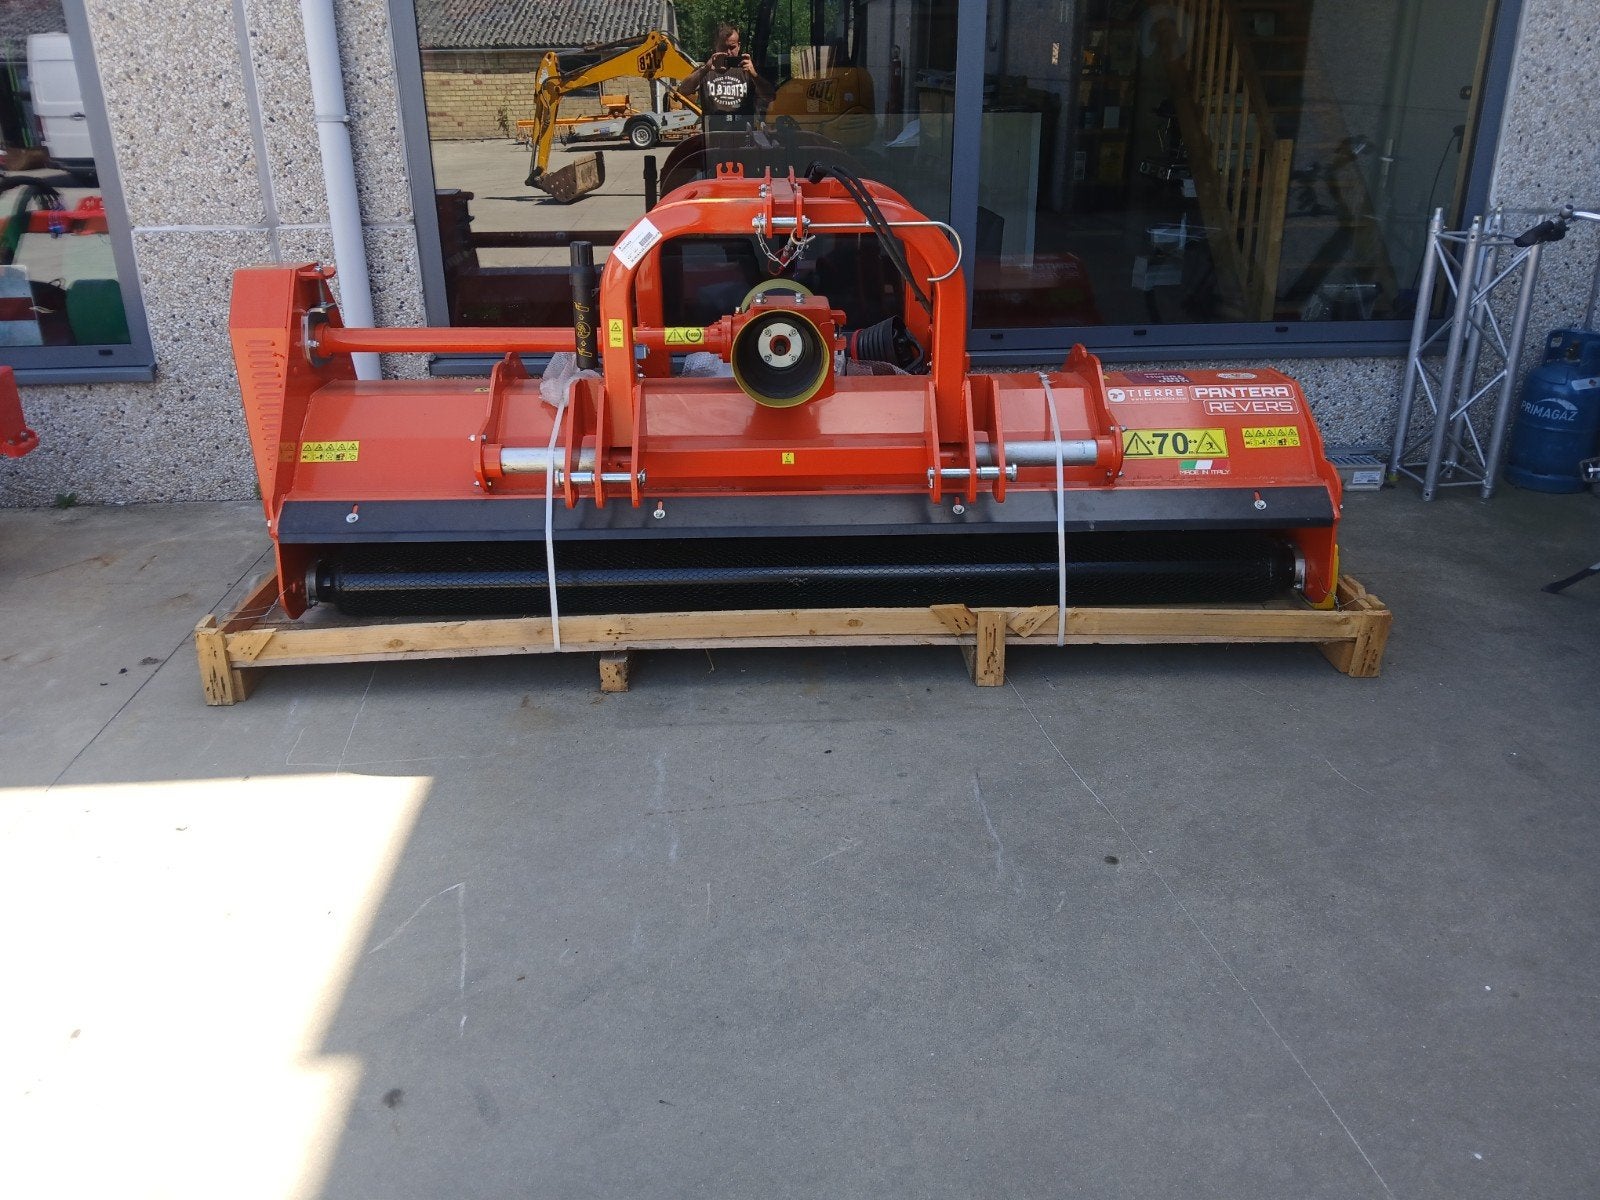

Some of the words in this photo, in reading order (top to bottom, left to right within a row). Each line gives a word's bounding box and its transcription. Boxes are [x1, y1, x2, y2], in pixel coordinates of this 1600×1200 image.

[1126, 387, 1184, 398] TIERRE
[1194, 386, 1290, 398] PANTERA
[1208, 401, 1294, 413] REVERS
[1520, 400, 1579, 421] PRIMAGAZ
[1152, 432, 1189, 455] 70
